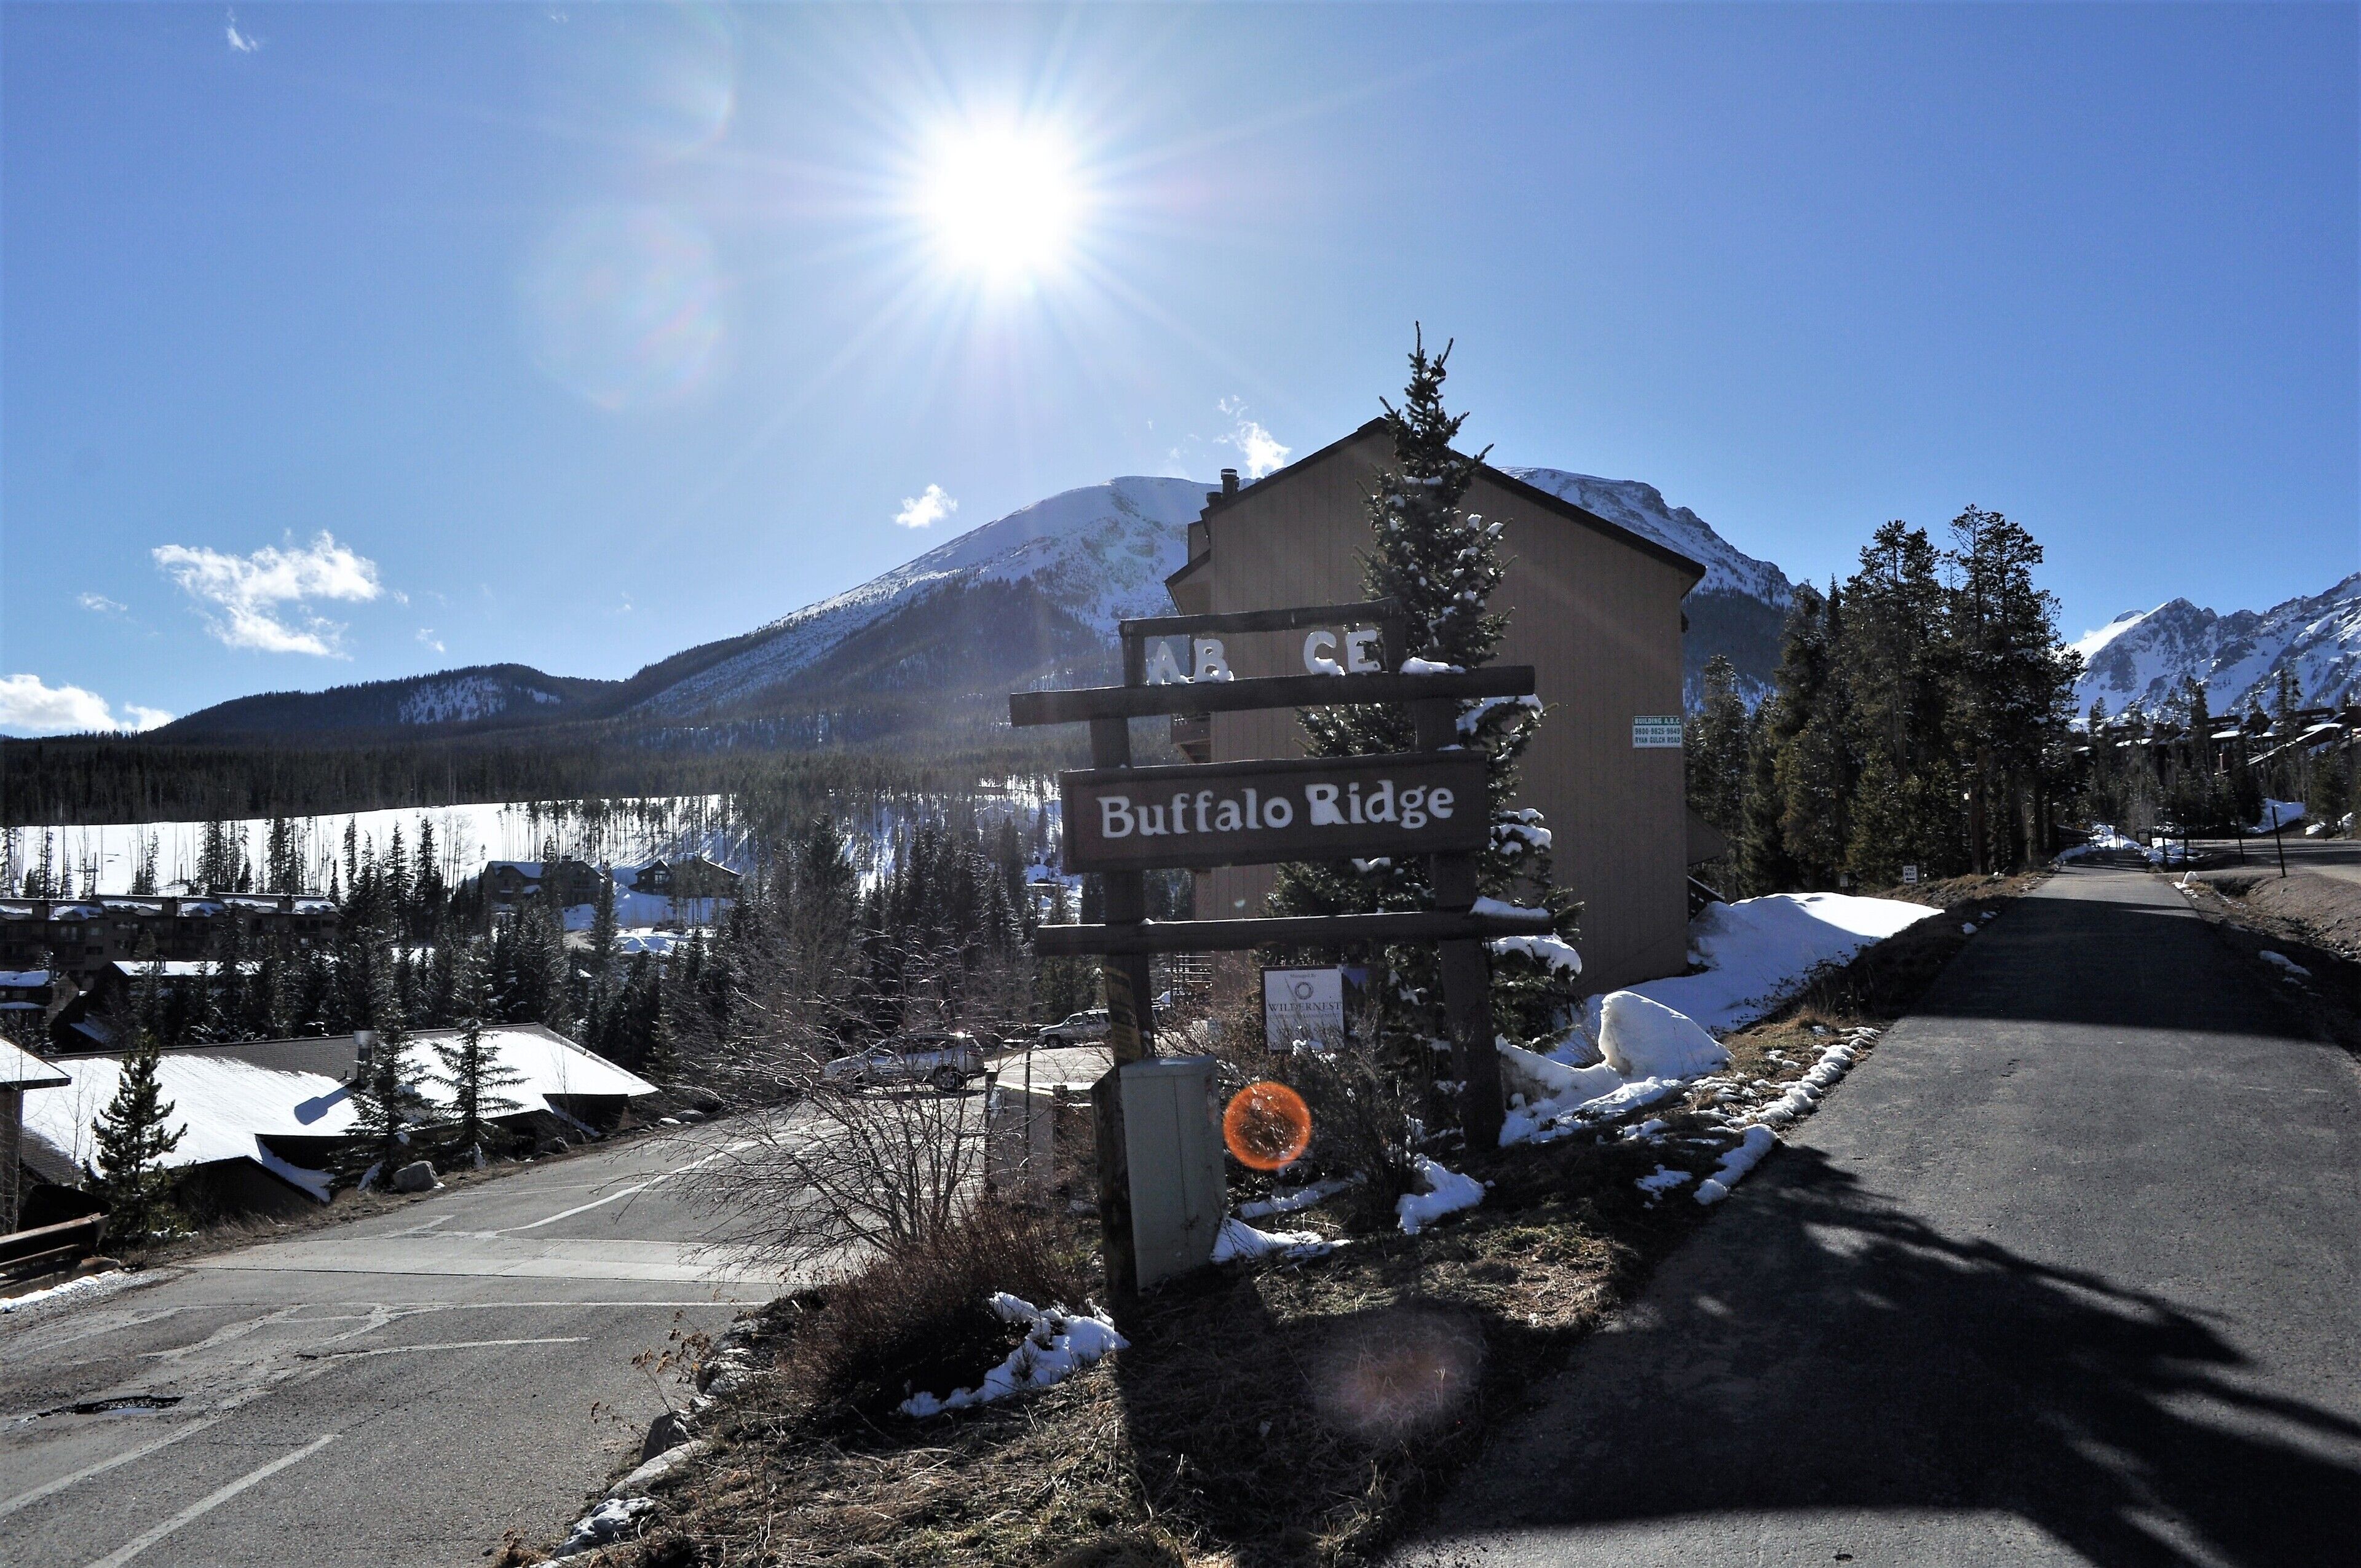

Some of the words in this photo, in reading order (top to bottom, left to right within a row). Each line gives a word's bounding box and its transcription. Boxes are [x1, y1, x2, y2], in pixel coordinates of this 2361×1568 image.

[1096, 788, 1293, 838] Buffalo
[1305, 780, 1454, 829] Ridge
[1268, 1002, 1342, 1012] WILDERNEST
